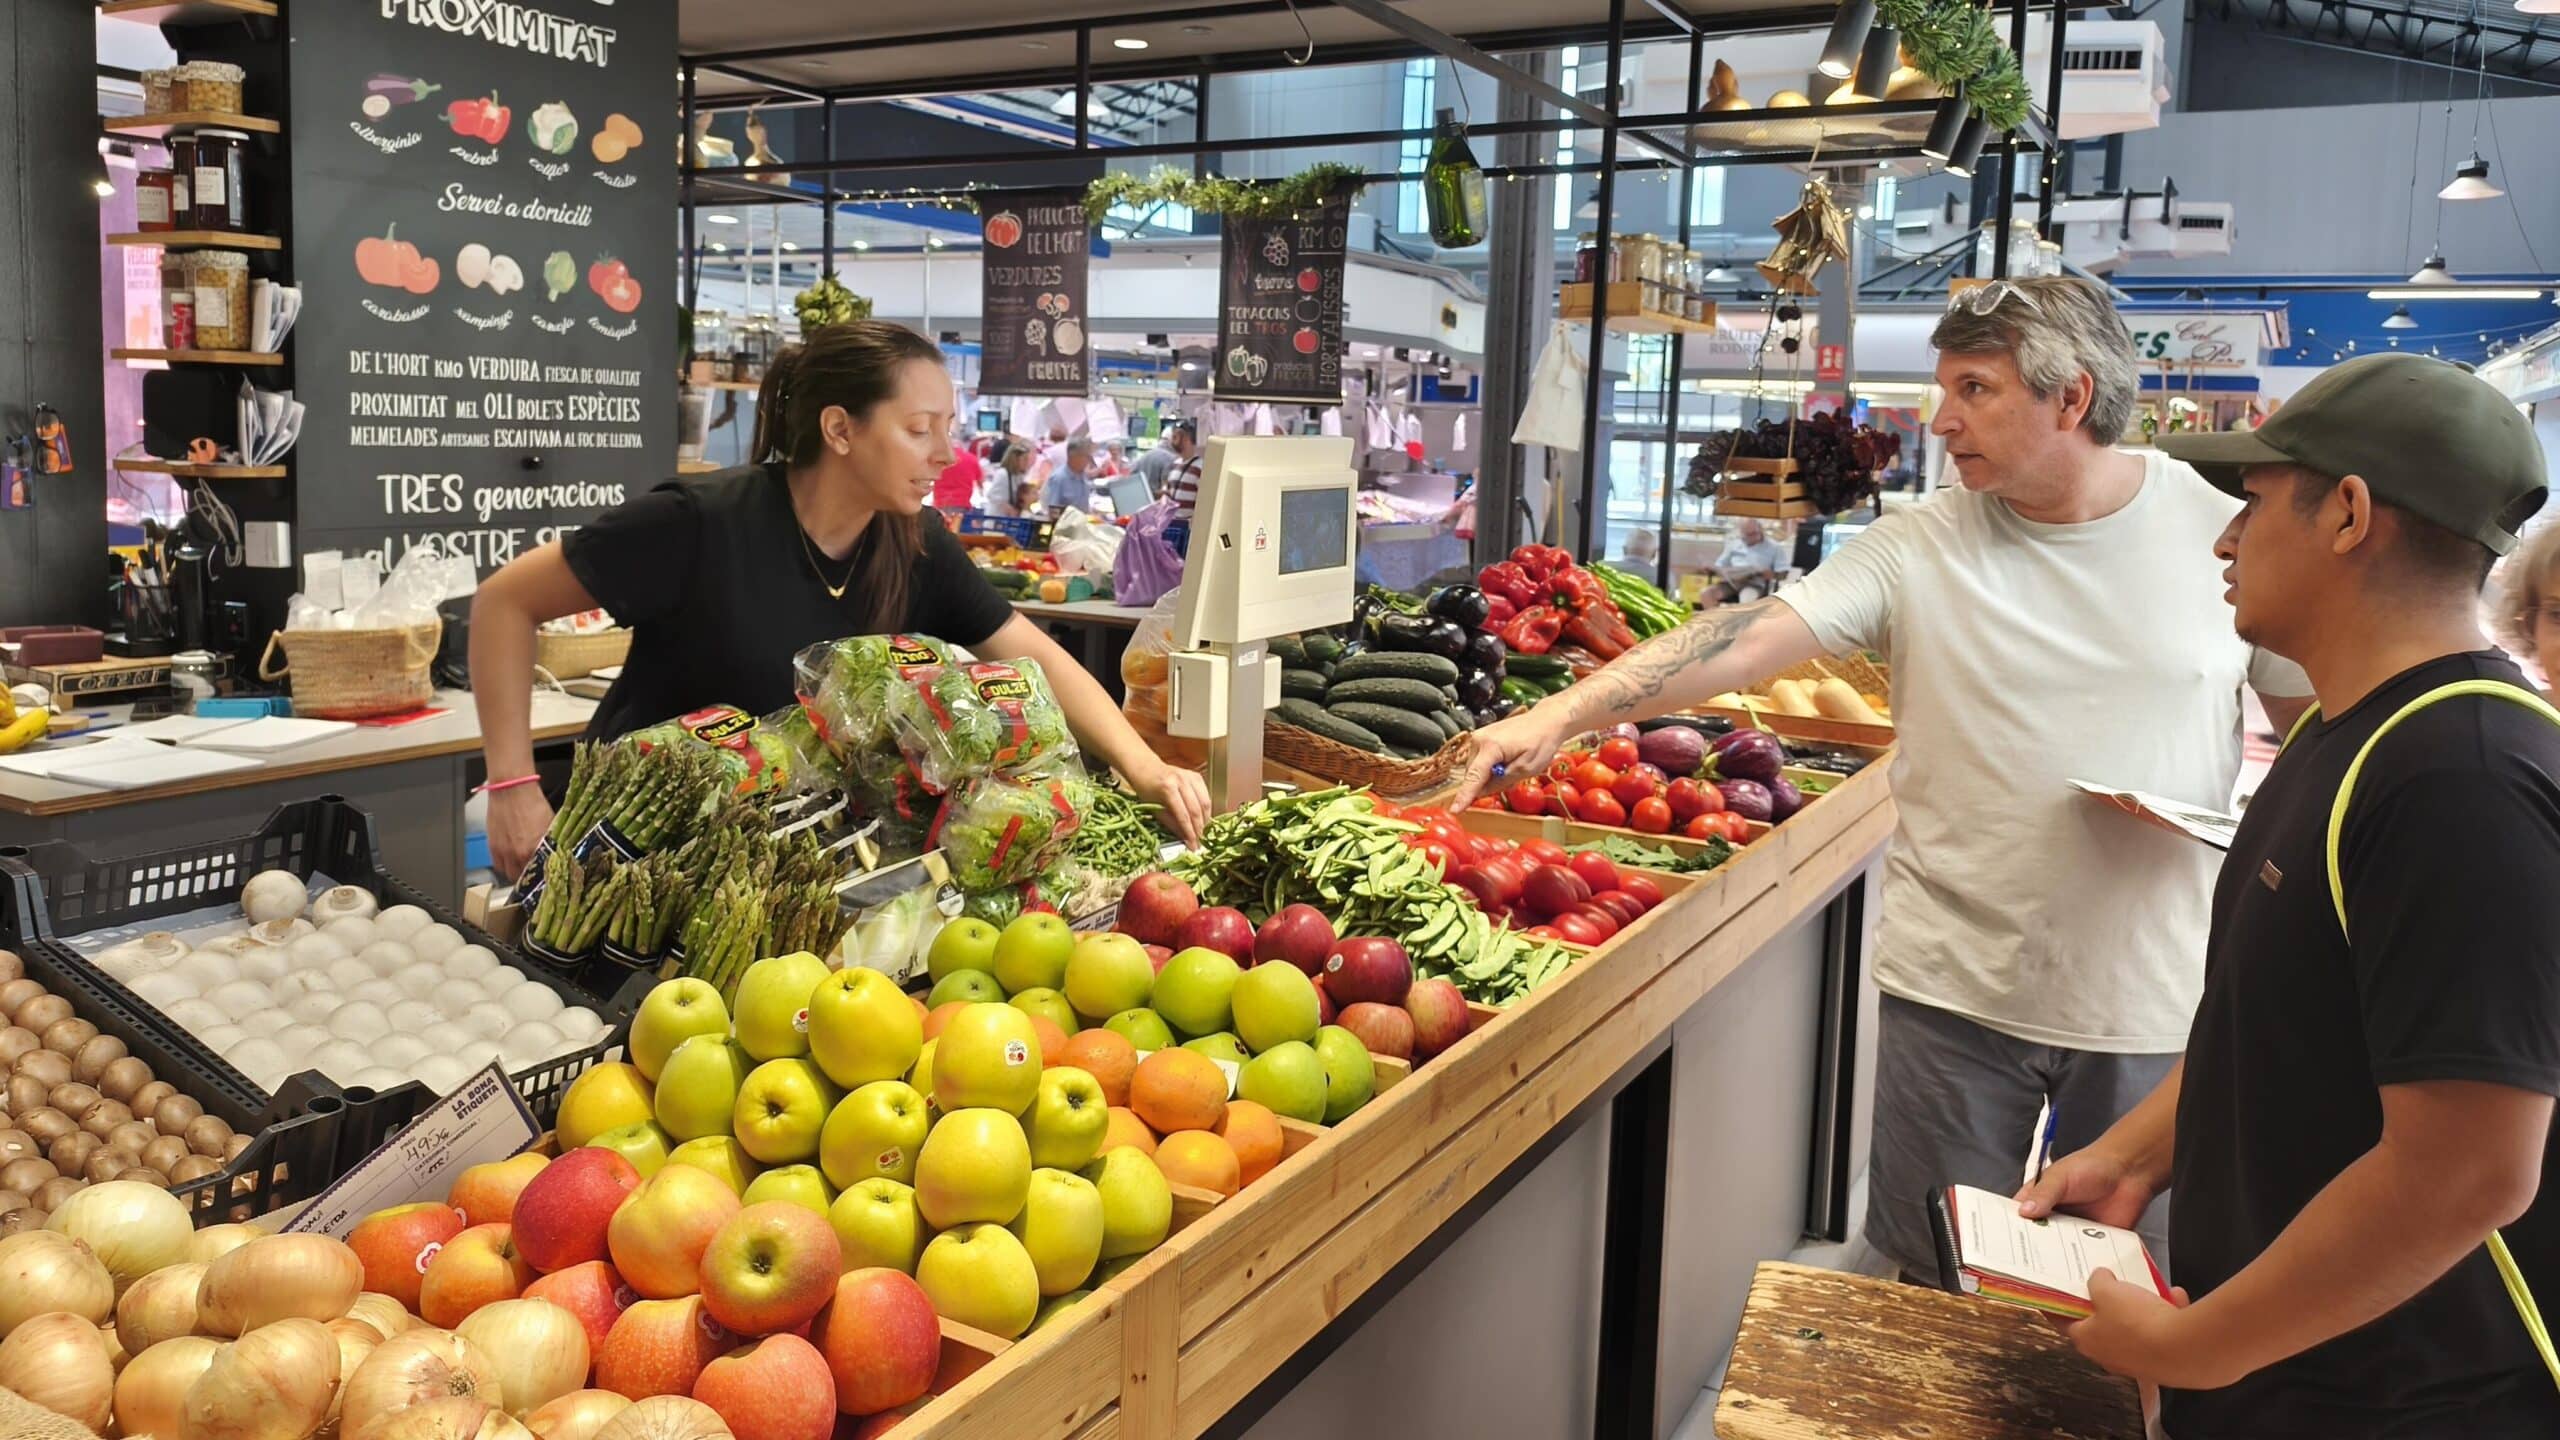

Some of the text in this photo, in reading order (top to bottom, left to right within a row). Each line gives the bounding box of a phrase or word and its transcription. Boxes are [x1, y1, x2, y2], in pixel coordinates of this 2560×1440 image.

[437, 183, 592, 228] Servei a domicili
[988, 265, 1062, 287] VERDURES
[350, 350, 371, 375] DE
[375, 351, 430, 377] L'HORT
[468, 355, 541, 382] VERDURA
[545, 365, 579, 383] FRESCA
[581, 368, 594, 384] DE
[595, 368, 641, 387] QUALITAT
[1028, 361, 1081, 381] FRUITA
[350, 389, 640, 423] PROXIMITAT MEL OLI BOLETS ESPÈCIES
[350, 425, 643, 449] MELMELADES ARTESANES ESCALIVADA AL FOC DE LLENYA
[376, 473, 625, 523] TRES generacions
[990, 681, 1029, 696] DULZE
[706, 713, 752, 738] DULZE
[451, 1076, 495, 1113] LA BONA
[456, 1084, 500, 1120] ETIQUETA
